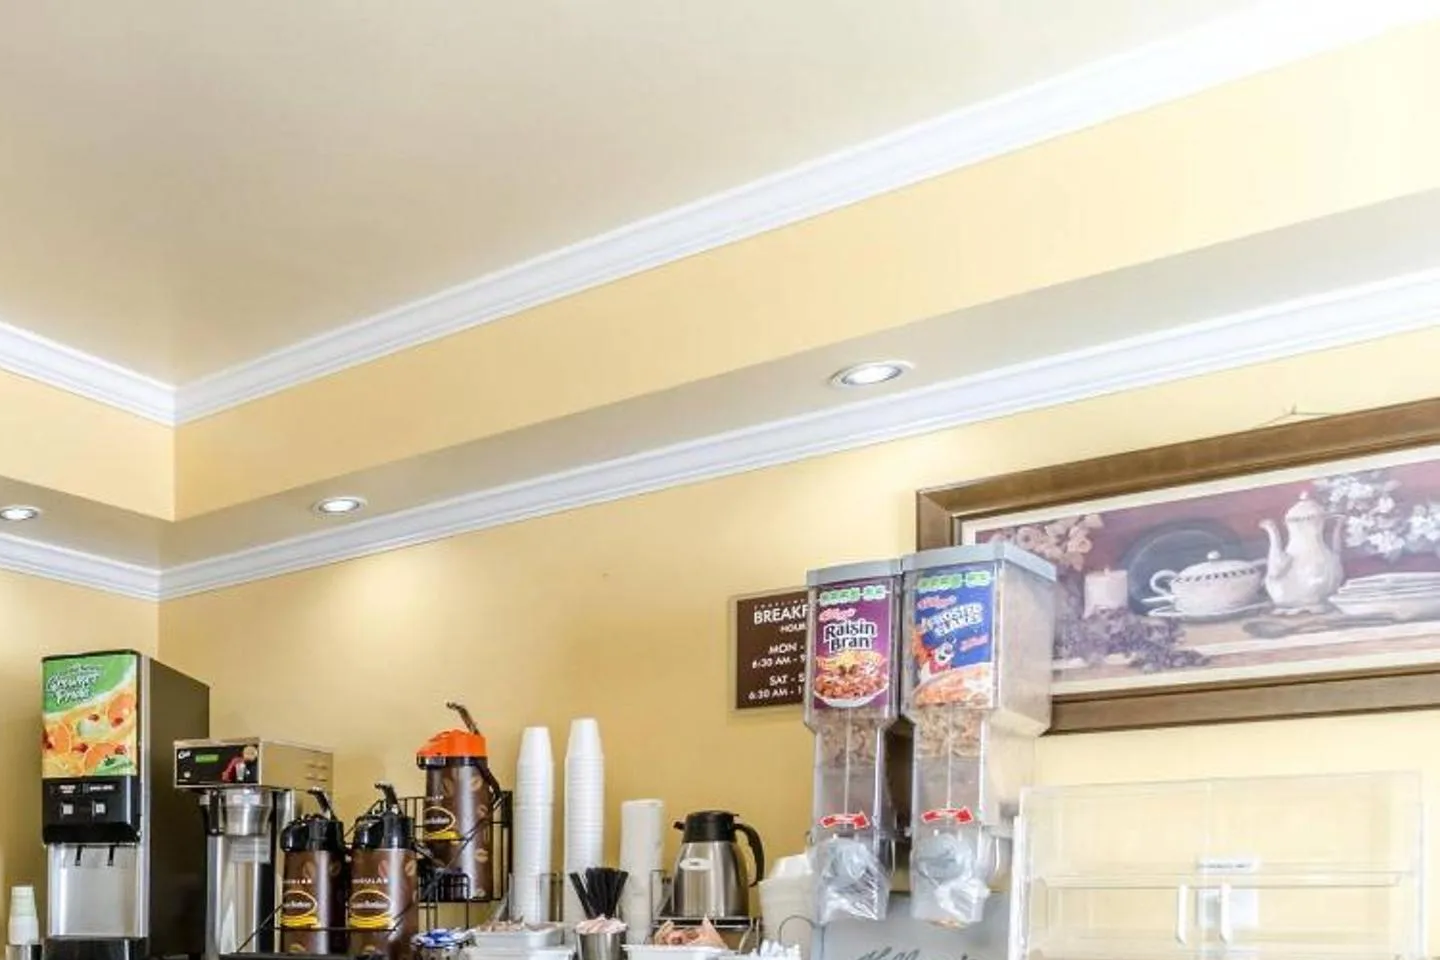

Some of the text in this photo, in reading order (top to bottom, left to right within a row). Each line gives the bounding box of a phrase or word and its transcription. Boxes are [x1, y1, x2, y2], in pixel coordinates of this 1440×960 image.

[753, 605, 808, 625] BREAKF
[780, 622, 807, 633] HOUR
[824, 620, 877, 641] Raisin
[768, 642, 797, 654] MON
[830, 635, 872, 651] Bran
[775, 656, 791, 666] AM
[769, 674, 788, 686] SAT
[772, 687, 788, 697] AM
